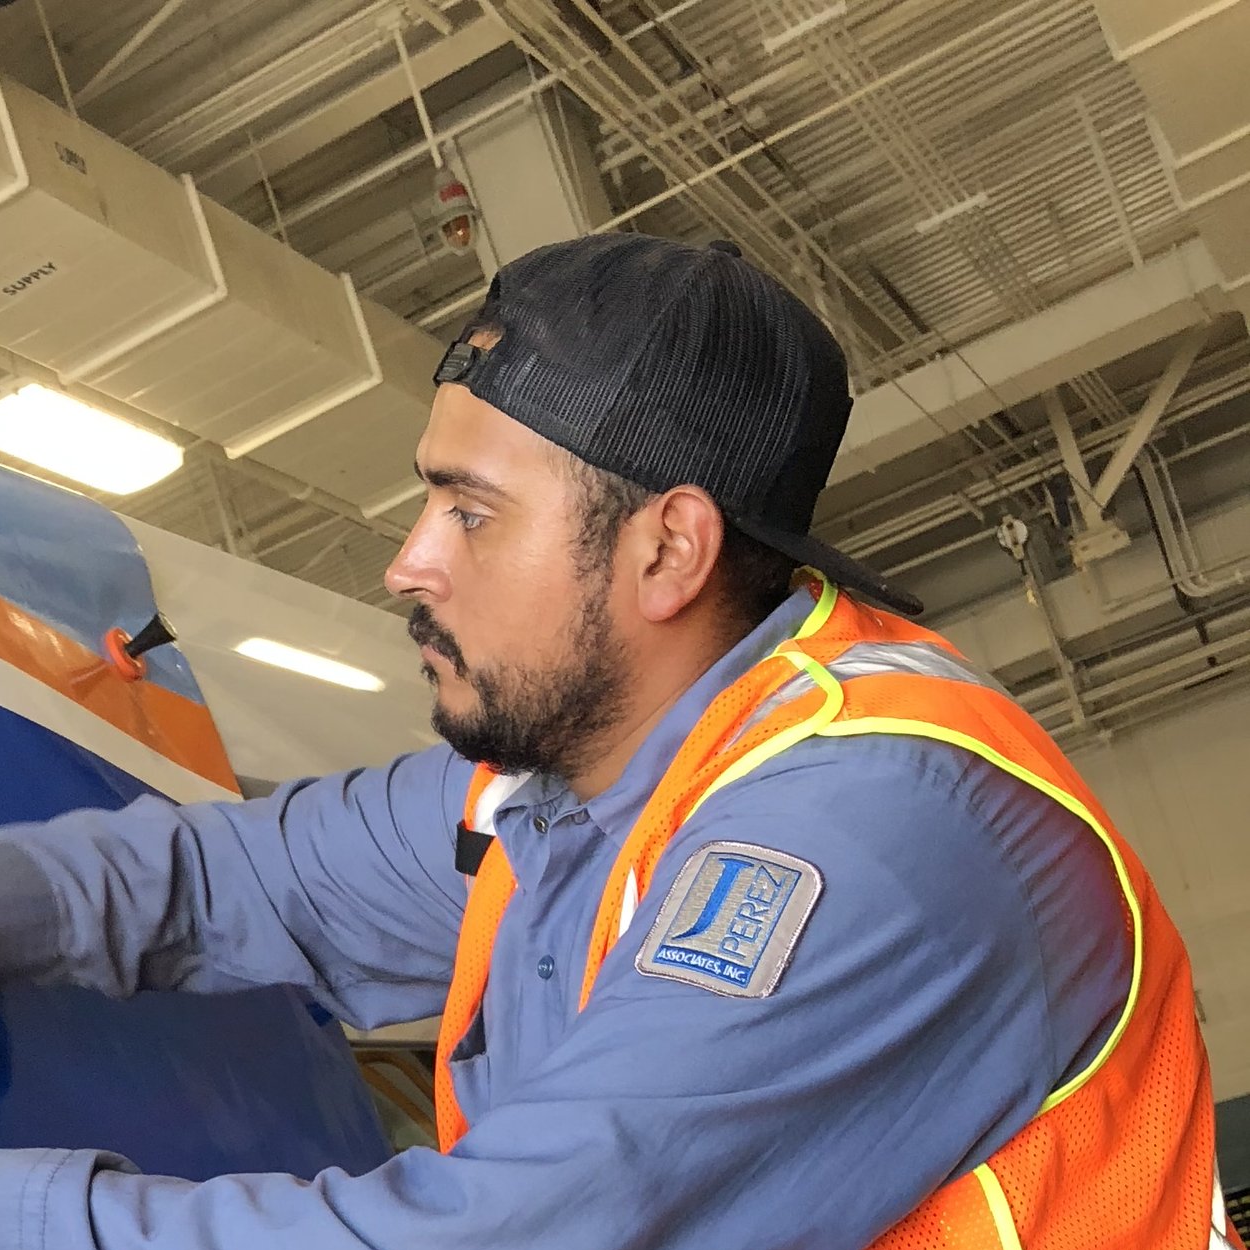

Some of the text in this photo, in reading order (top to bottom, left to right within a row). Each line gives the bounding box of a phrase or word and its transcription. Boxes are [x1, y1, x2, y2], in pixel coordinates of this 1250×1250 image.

[2, 261, 57, 296] SUPPLY
[671, 857, 755, 940] J
[718, 865, 786, 960] PEREZ
[657, 949, 748, 983] ASSOCIATES, INC.
